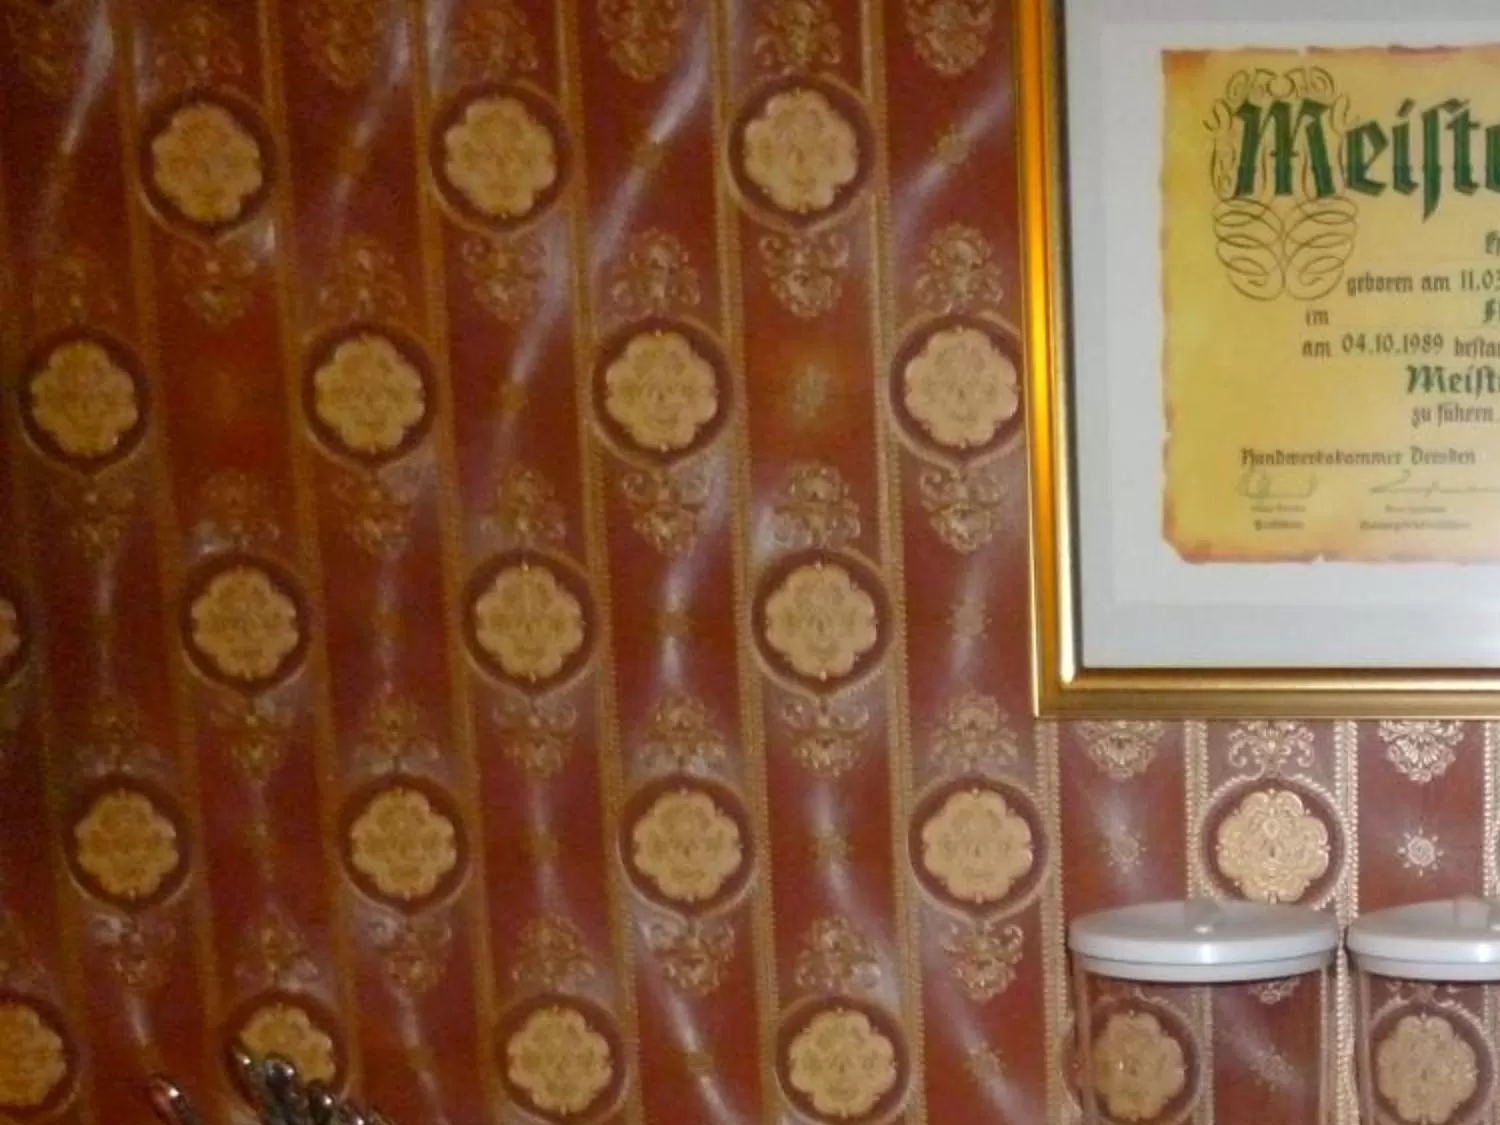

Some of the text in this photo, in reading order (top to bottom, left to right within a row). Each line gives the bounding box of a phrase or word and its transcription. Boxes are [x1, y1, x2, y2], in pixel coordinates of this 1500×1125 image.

[1346, 271, 1414, 297] geboren
[1421, 275, 1450, 293] am
[1305, 308, 1330, 327] im
[1302, 339, 1331, 358] am
[1341, 332, 1445, 355] 04.10.1989
[1411, 406, 1432, 429] zu
